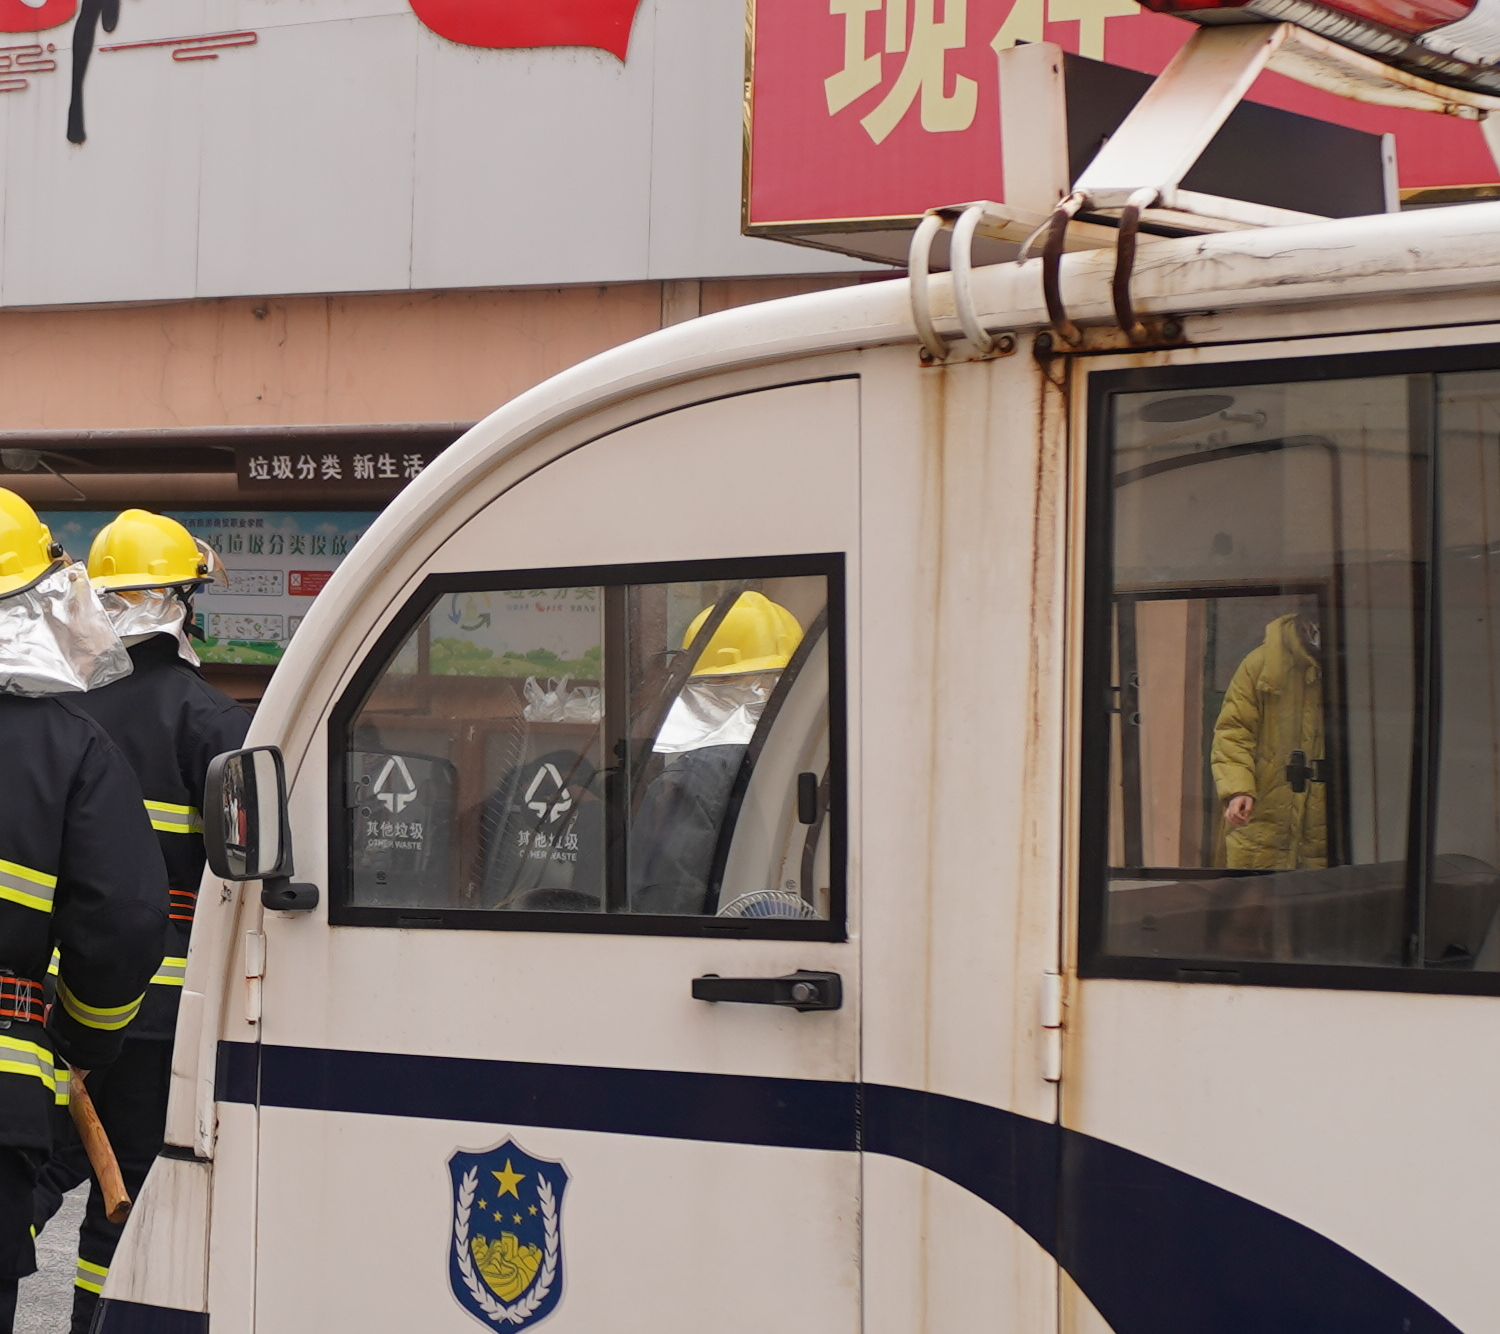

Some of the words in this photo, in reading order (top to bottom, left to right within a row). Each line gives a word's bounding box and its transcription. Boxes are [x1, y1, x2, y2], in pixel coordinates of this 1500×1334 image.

[249, 453, 343, 480] 垃圾分类
[353, 452, 425, 479] 新生活
[366, 820, 424, 840] 其他垃圾
